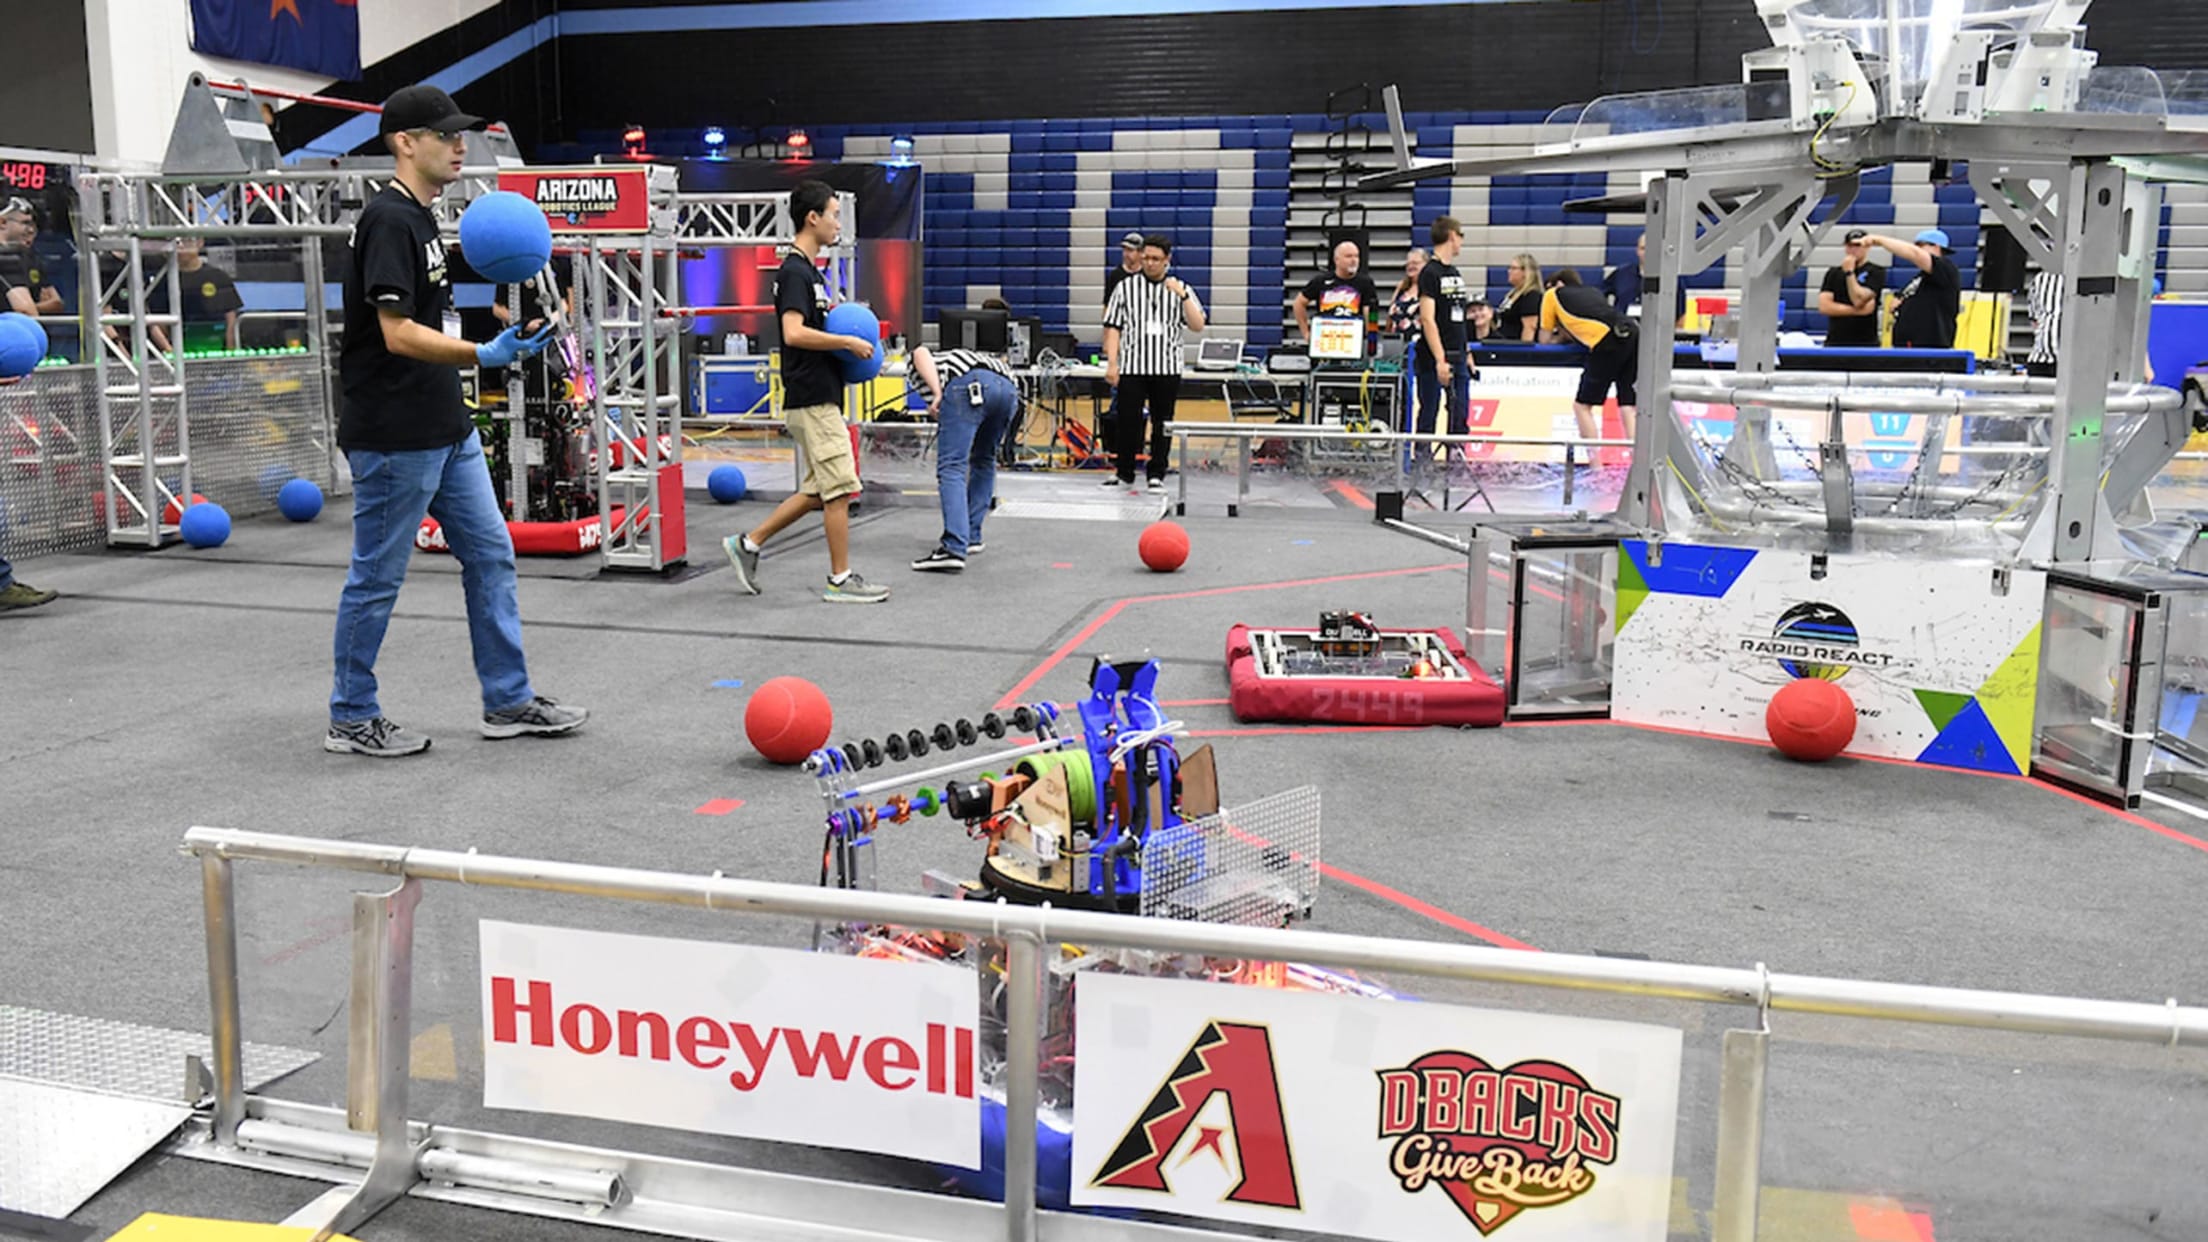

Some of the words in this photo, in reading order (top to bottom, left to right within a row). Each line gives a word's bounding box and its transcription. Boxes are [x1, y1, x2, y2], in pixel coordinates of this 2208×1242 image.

[536, 178, 618, 201] ARIZONA
[1740, 639, 1809, 657] RAPID
[1814, 649, 1894, 667] REACT
[1312, 686, 1425, 722] 2449
[491, 976, 974, 1100] Honeywell
[1393, 1133, 1483, 1189] Give
[1474, 1146, 1592, 1205] Back
